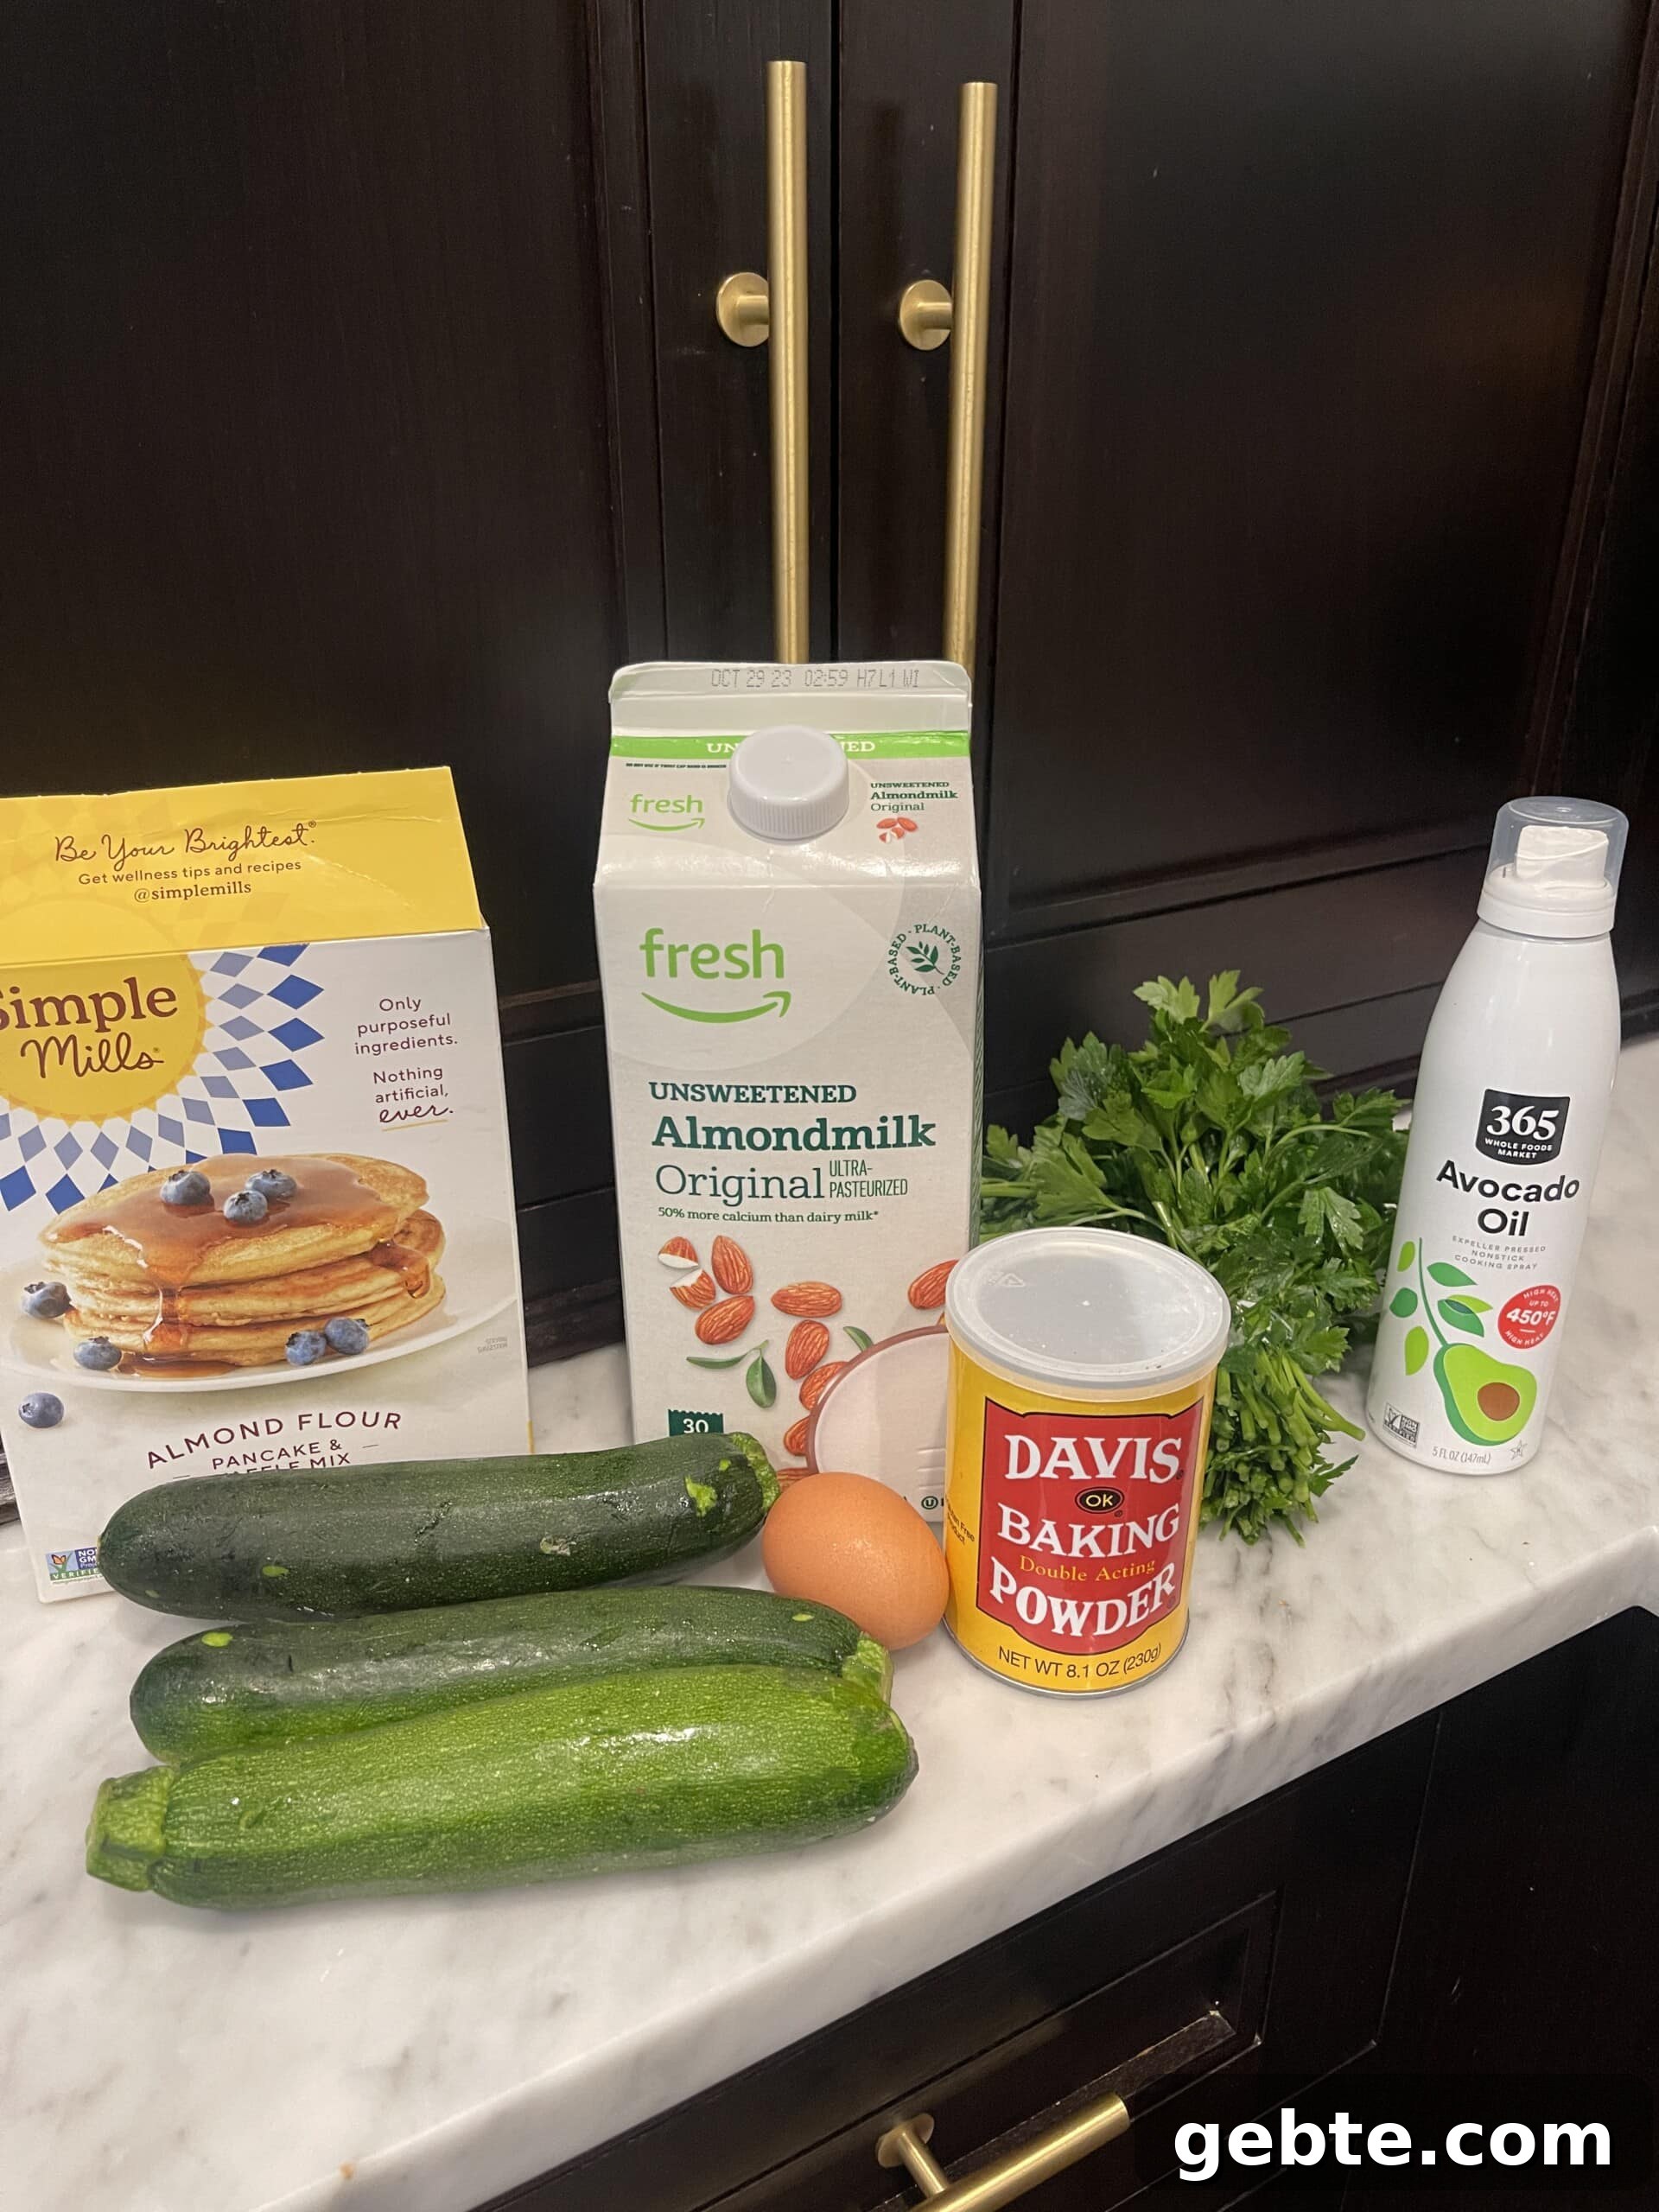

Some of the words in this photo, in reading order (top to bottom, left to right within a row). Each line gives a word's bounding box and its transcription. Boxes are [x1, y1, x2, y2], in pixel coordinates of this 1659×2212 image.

[711, 669, 741, 688] OCT
[746, 669, 766, 689] 29
[771, 669, 792, 689] 23
[804, 669, 849, 688] 02:59
[630, 793, 703, 813] fresh
[870, 790, 958, 800] Almondmilk
[870, 802, 925, 813] Original
[55, 836, 97, 862] Be
[101, 834, 175, 872] Your
[79, 873, 108, 885] Get
[112, 870, 178, 883] wellness
[182, 867, 211, 881] tips
[215, 863, 242, 876] and
[247, 861, 302, 874] recipes
[134, 880, 251, 904] @simplemills
[639, 927, 785, 981] fresh
[378, 996, 422, 1012] Only
[357, 1012, 451, 1038] purposeful
[20, 1032, 165, 1079] Mills
[354, 1034, 458, 1057] ingredients.
[373, 1067, 443, 1084] Nothing
[375, 1084, 448, 1103] artificial,
[648, 1081, 857, 1103] UNSWEETENED
[379, 1104, 454, 1123] ever.
[1486, 1105, 1560, 1141] 365
[652, 1114, 937, 1152] Almondmilk
[1484, 1137, 1519, 1149] WHOLE
[1521, 1143, 1553, 1152] FOODS
[1497, 1148, 1537, 1160] MARKET
[829, 1159, 874, 1177] ULTRA-
[655, 1164, 825, 1208] Original
[829, 1179, 909, 1198] PASTEURIZED
[1435, 1159, 1580, 1203] Avocado
[658, 1206, 685, 1218] 50%
[687, 1210, 720, 1222] more
[722, 1209, 772, 1223] calcium
[774, 1211, 804, 1223] than
[807, 1211, 841, 1224] dairy
[1477, 1208, 1529, 1236] Oil
[1452, 1236, 1501, 1252] EXPELLER
[1503, 1245, 1547, 1254] PRESSED
[1471, 1249, 1525, 1262] NONSTICK
[1454, 1254, 1503, 1269] COOKING
[1506, 1262, 1538, 1271] SPRAY
[147, 1418, 283, 1469] ALMOND
[298, 1411, 402, 1431] FLOUR
[212, 1441, 321, 1471] PANCAKE
[329, 1439, 343, 1451] &
[309, 1452, 353, 1470] MIX
[1004, 1434, 1183, 1484] DAVIS
[1432, 1446, 1439, 1457] 5
[1439, 1448, 1448, 1459] FL
[1449, 1450, 1459, 1461] OZ
[1085, 1494, 1114, 1509] OK
[997, 1503, 1180, 1559] BAKING
[78, 1548, 97, 1558] NO
[1019, 1554, 1088, 1582] Double
[1094, 1559, 1156, 1581] Acting
[988, 1556, 1176, 1637] POWDER
[998, 1645, 1031, 1669] NET
[1034, 1657, 1064, 1677] WT
[1066, 1663, 1090, 1679] 8.1
[1096, 1660, 1121, 1677] OZ
[1122, 1642, 1162, 1675] (230g)
